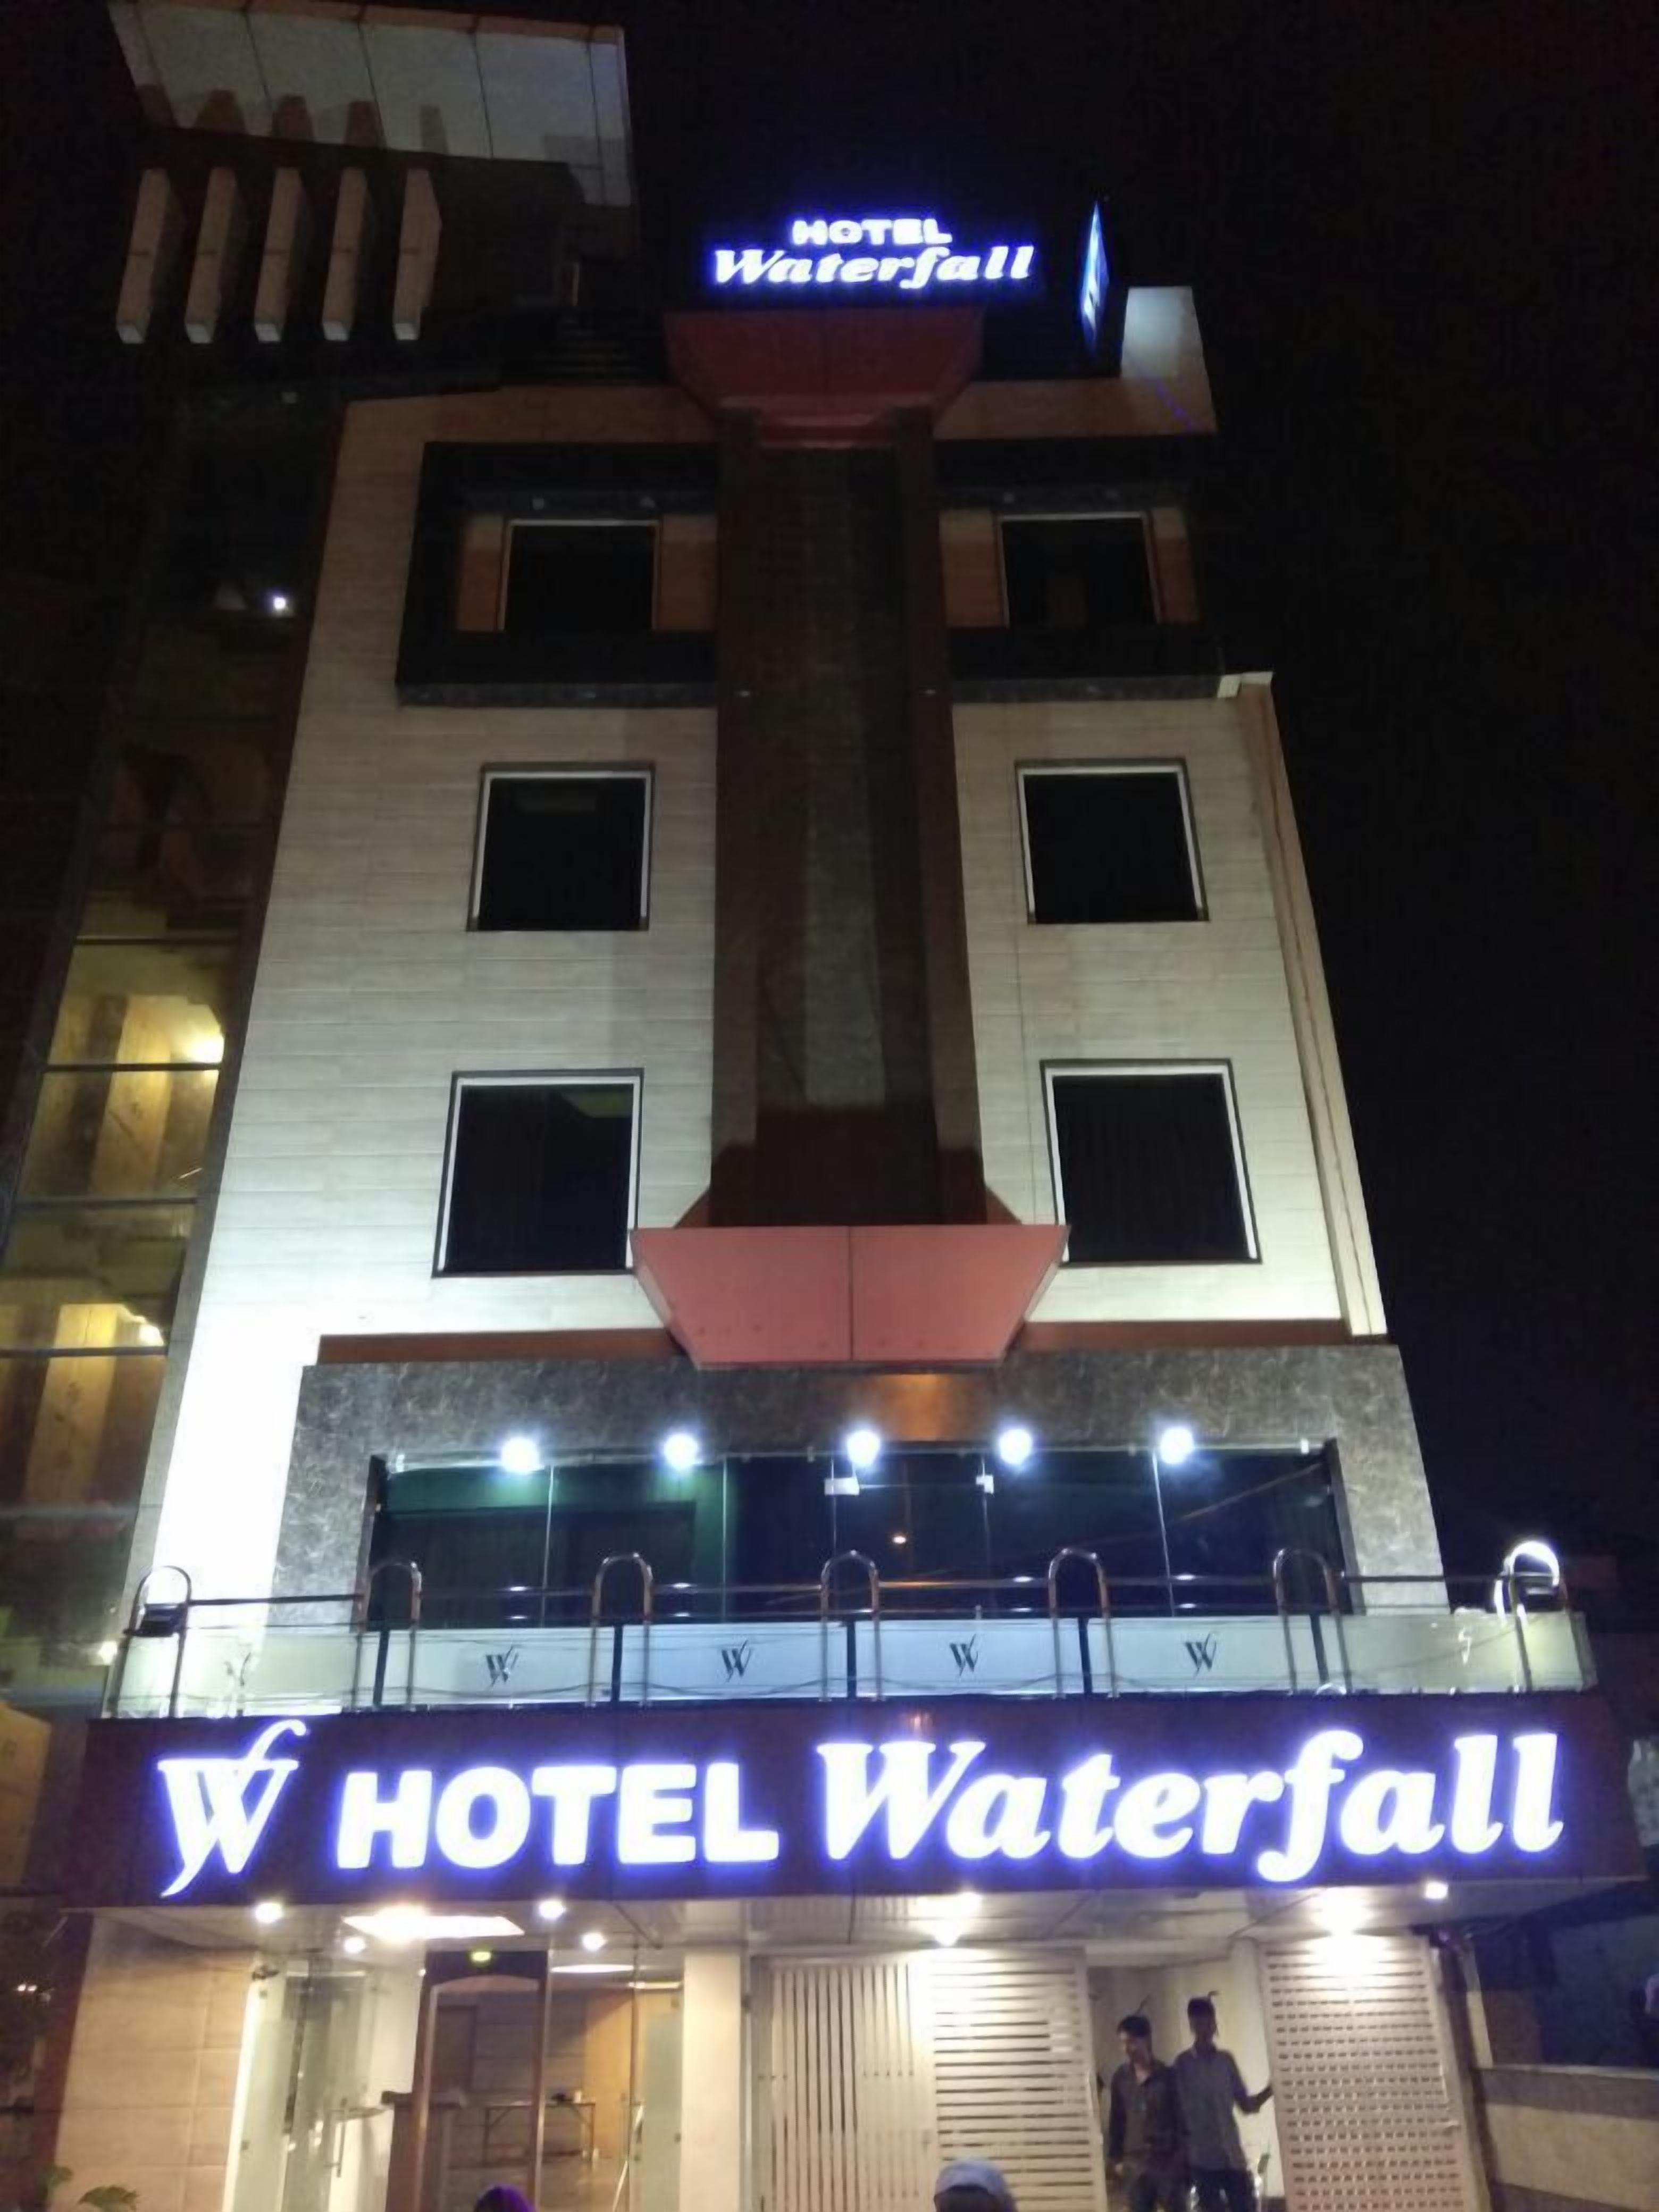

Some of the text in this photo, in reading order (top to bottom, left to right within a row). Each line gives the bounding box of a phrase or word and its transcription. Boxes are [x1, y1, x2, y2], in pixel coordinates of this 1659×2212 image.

[791, 218, 953, 246] HOTEL
[715, 245, 1035, 289] Waterfall
[335, 1728, 1564, 1883] HOTEL Waterfall
